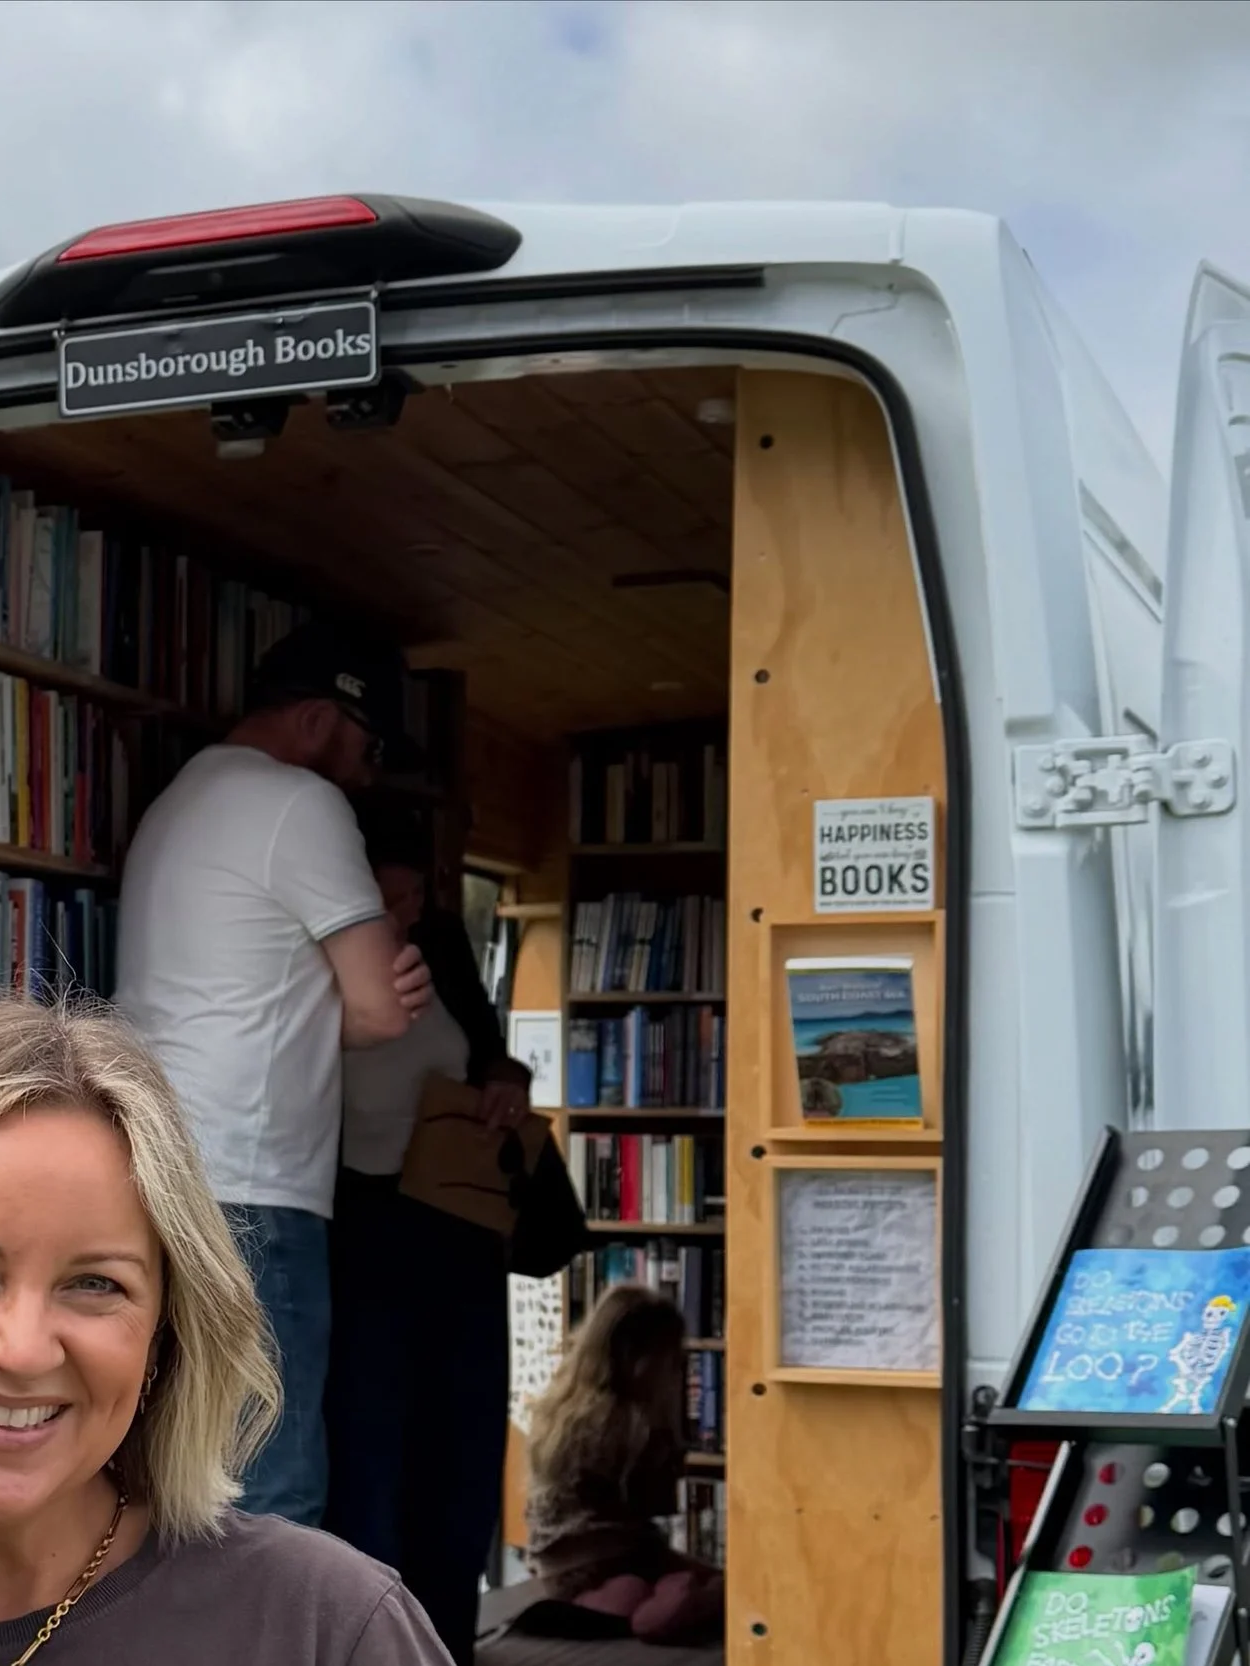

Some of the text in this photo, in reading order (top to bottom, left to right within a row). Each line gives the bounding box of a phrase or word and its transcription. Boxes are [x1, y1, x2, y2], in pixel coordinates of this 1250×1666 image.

[66, 328, 371, 390] Dunsborough Books
[819, 822, 929, 844] HAPPINESS
[820, 863, 929, 896] BOOKS
[1044, 1591, 1088, 1615] DO
[1033, 1594, 1177, 1649] SKELETONS
